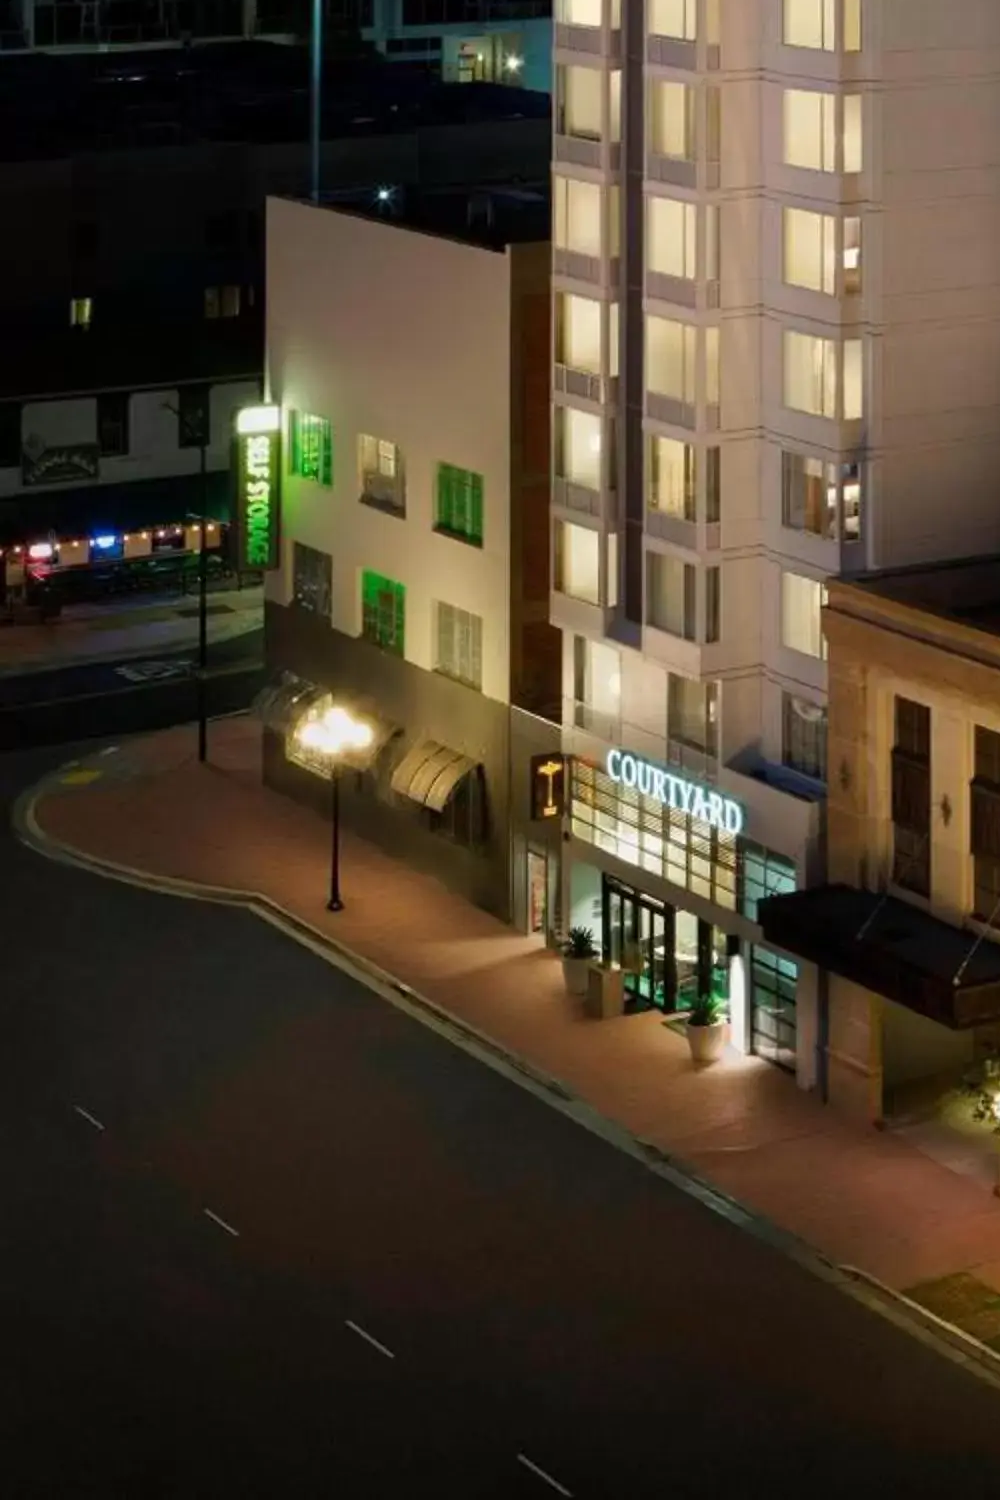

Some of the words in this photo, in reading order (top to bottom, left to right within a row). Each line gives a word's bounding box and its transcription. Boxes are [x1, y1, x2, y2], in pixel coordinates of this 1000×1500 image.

[247, 435, 270, 479] SELF
[247, 481, 270, 564] STORAGE
[607, 749, 743, 834] COURTYARD
